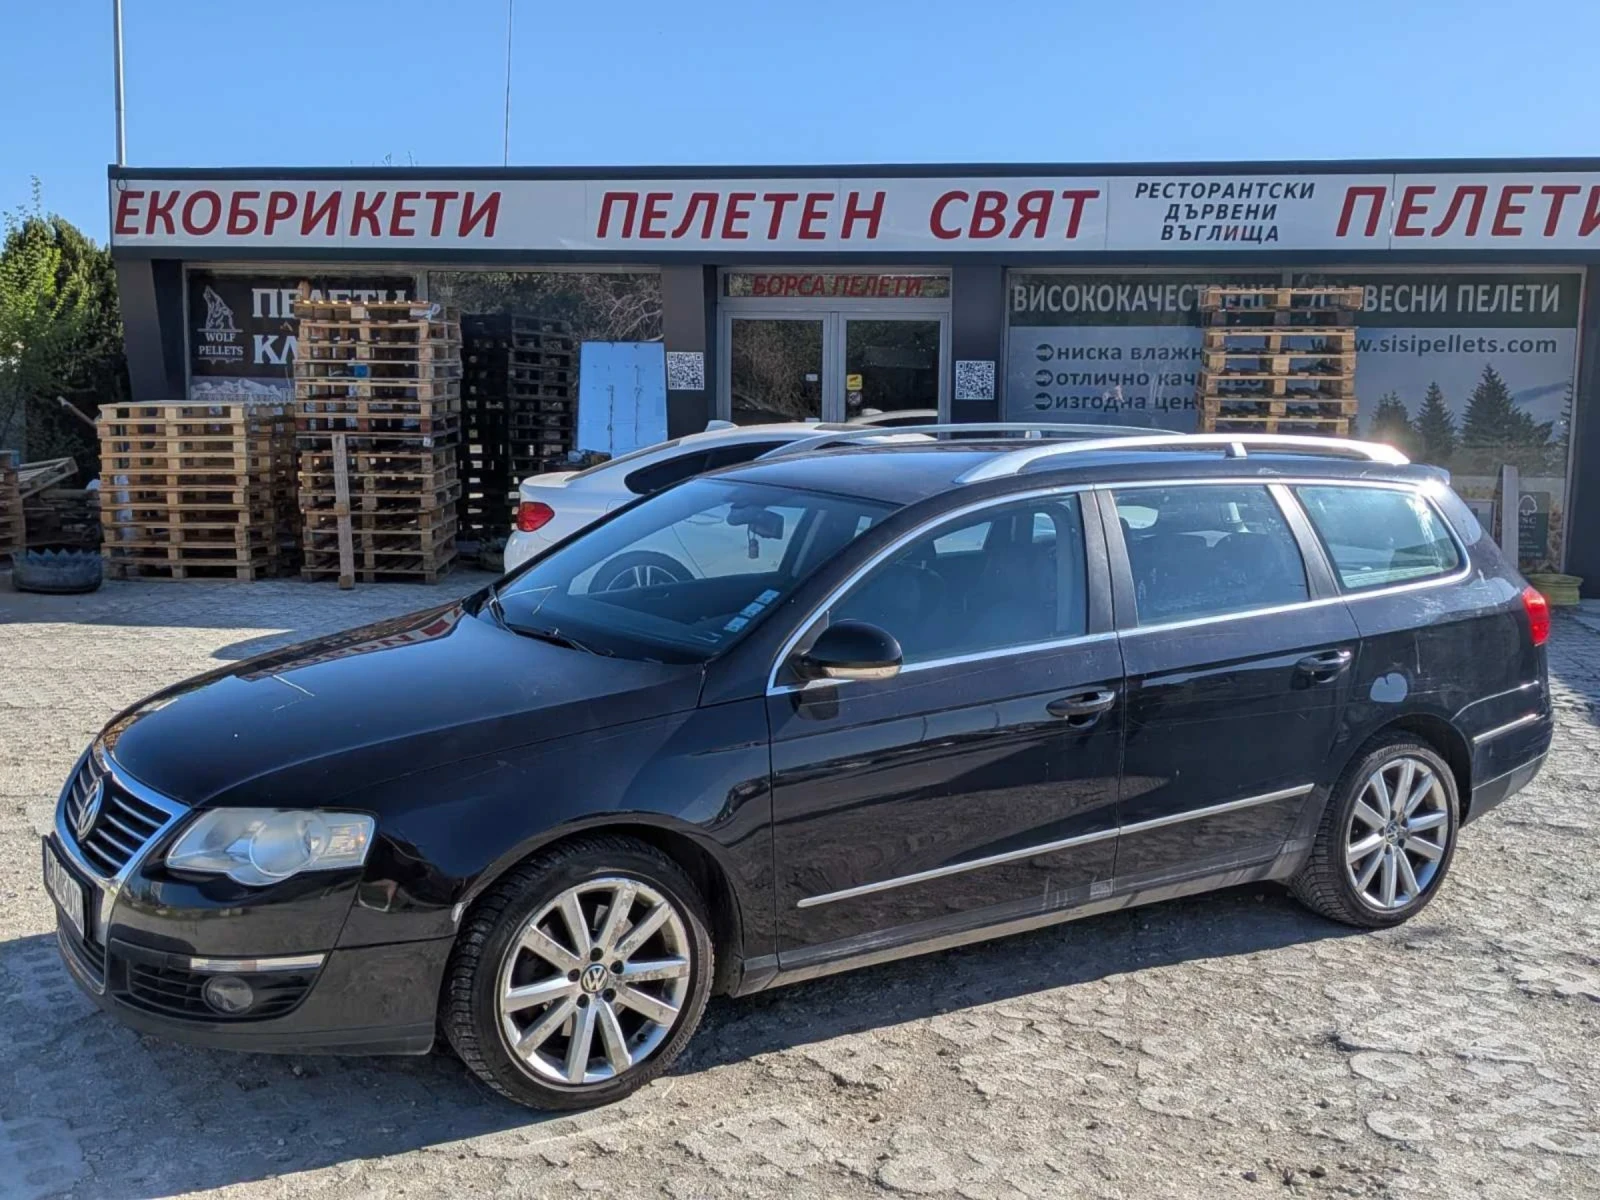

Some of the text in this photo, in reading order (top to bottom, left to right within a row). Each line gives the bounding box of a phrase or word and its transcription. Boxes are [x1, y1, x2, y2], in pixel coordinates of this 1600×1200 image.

[1135, 182, 1315, 199] РЕСТОРАНТСКИ
[115, 190, 502, 237] ЕКОБРИКЕТИ
[597, 190, 1099, 239] ПЕЛЕТЕН СВЯТ
[1164, 203, 1278, 223] ДЪРВЕНИ
[1160, 225, 1279, 244] ВЪГЛИЩА
[753, 276, 923, 296] БОРСА ПЕЛЕТИ
[1307, 284, 1448, 317] ДВЕСНИ
[1457, 283, 1560, 313] ПЕЛЕТИ
[205, 332, 236, 343] WOLF
[1311, 334, 1557, 357] ww.sisipellets.com
[199, 345, 244, 356] PELLETS
[1057, 346, 1122, 361] ниска
[1056, 372, 1149, 386] отлично
[1055, 397, 1146, 413] изгодна
